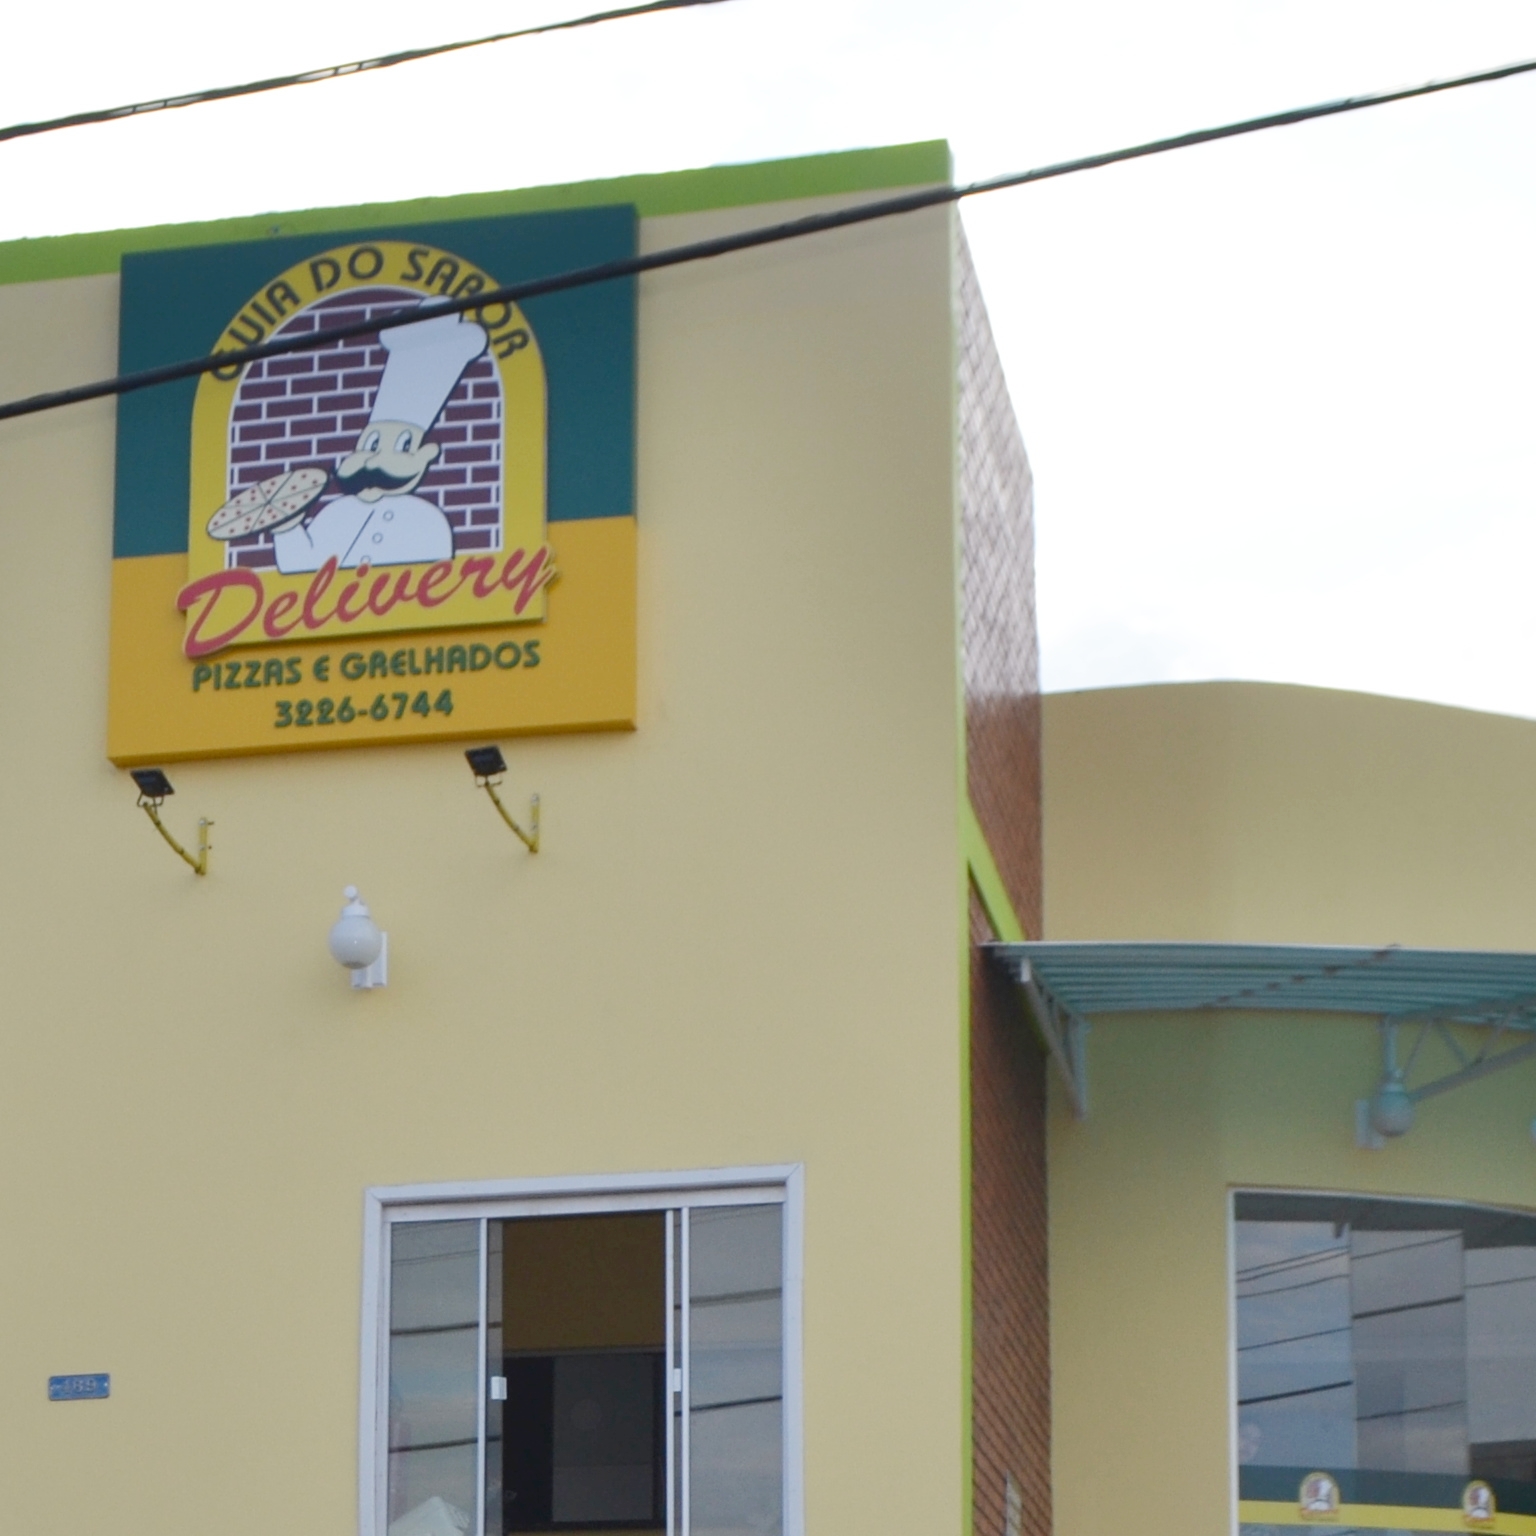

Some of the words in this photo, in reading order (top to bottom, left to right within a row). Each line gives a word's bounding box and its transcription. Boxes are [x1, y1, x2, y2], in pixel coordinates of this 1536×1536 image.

[309, 246, 384, 292] DO
[177, 547, 548, 659] Delivery
[193, 657, 302, 692] PIZZAS
[313, 655, 329, 682] E
[340, 640, 541, 681] GRELHADOS
[275, 690, 454, 728] 3226-6744
